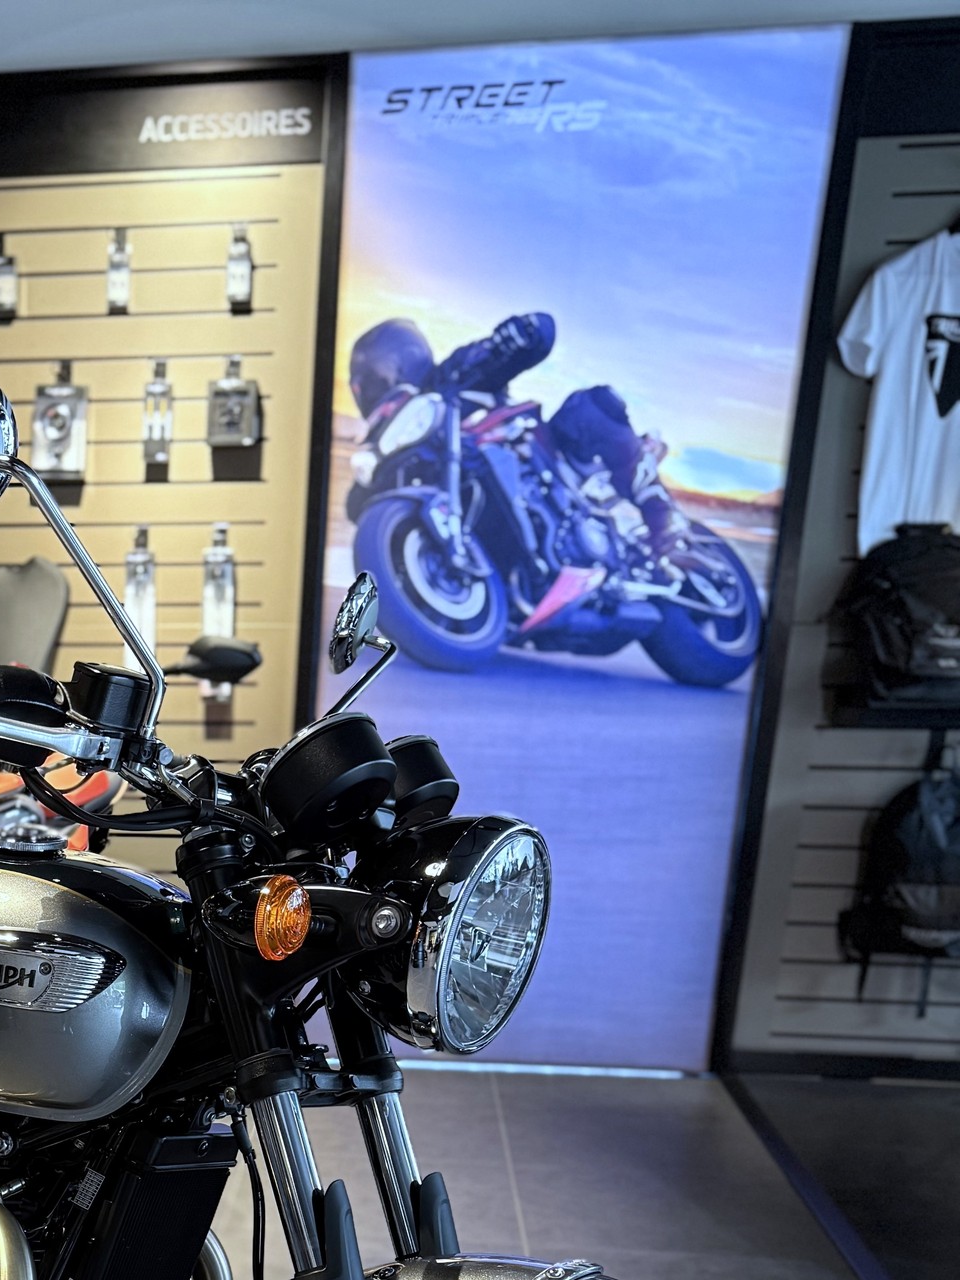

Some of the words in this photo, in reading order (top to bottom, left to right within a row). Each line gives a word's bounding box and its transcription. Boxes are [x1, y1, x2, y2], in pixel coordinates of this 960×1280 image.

[382, 79, 568, 115] STREET
[138, 106, 313, 144] ACCESSOIRES
[534, 100, 608, 133] RS
